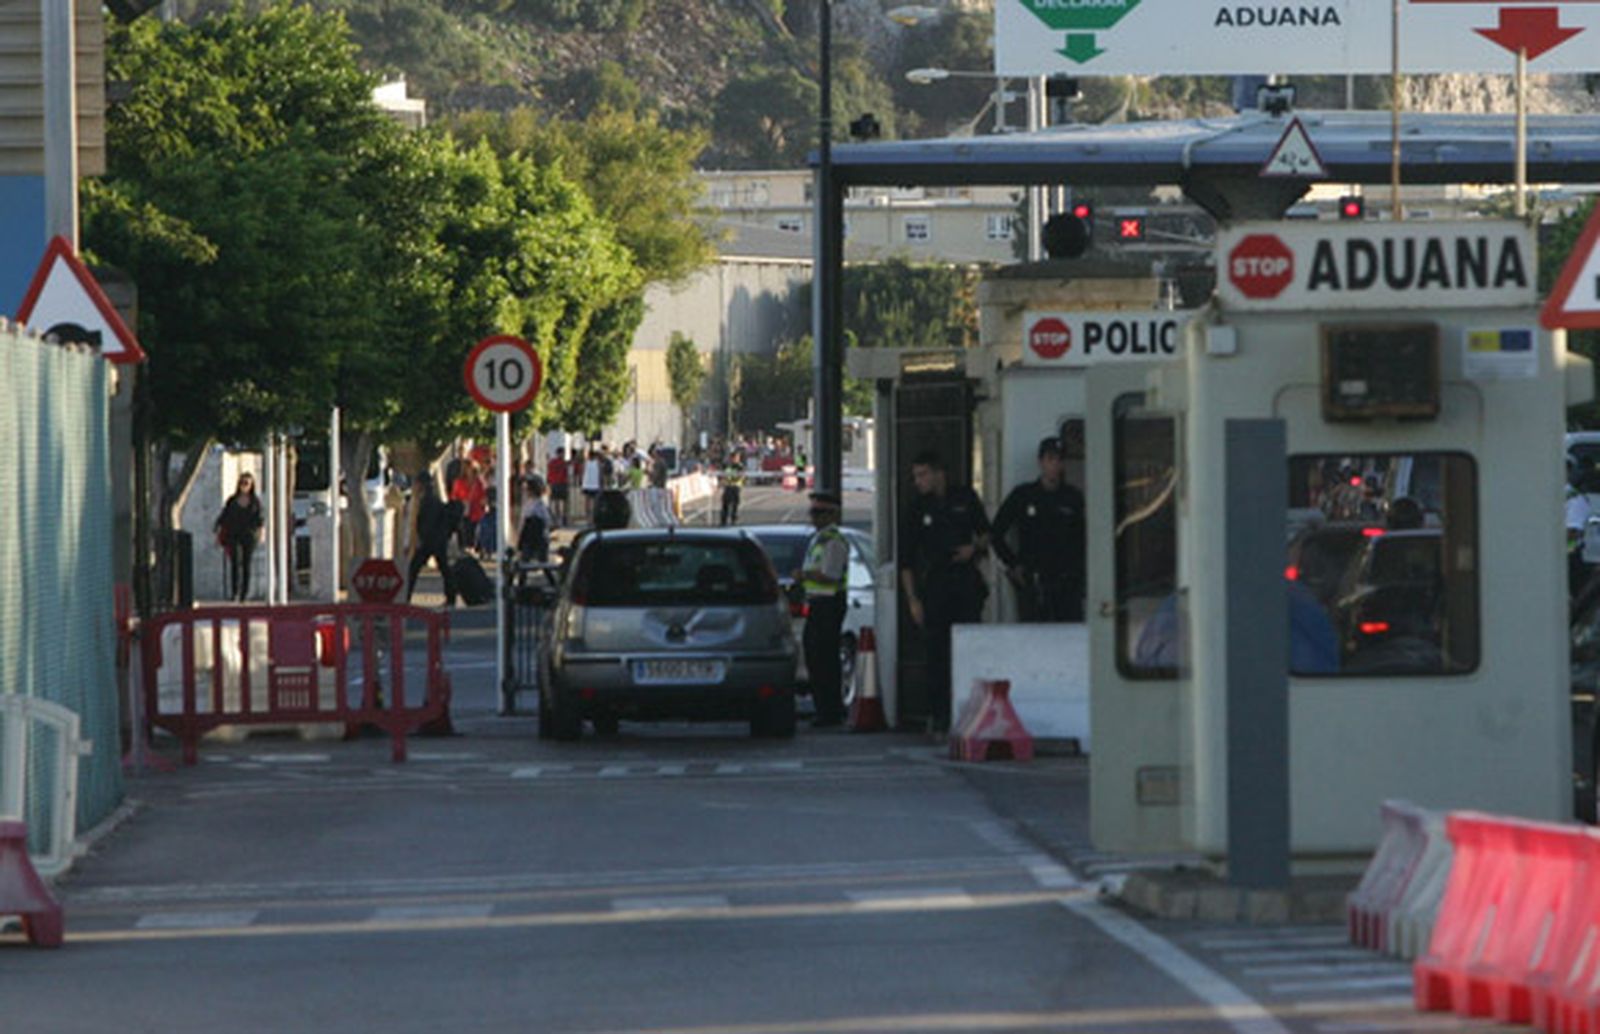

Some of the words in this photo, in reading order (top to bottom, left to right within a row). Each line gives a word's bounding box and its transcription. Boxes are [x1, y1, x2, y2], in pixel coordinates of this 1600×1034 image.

[1214, 7, 1341, 26] ADUANA
[1233, 257, 1288, 277] STOP
[1307, 237, 1527, 290] ADUANA
[1032, 332, 1069, 346] STOP
[485, 358, 524, 391] 10
[356, 574, 400, 590] STOP
